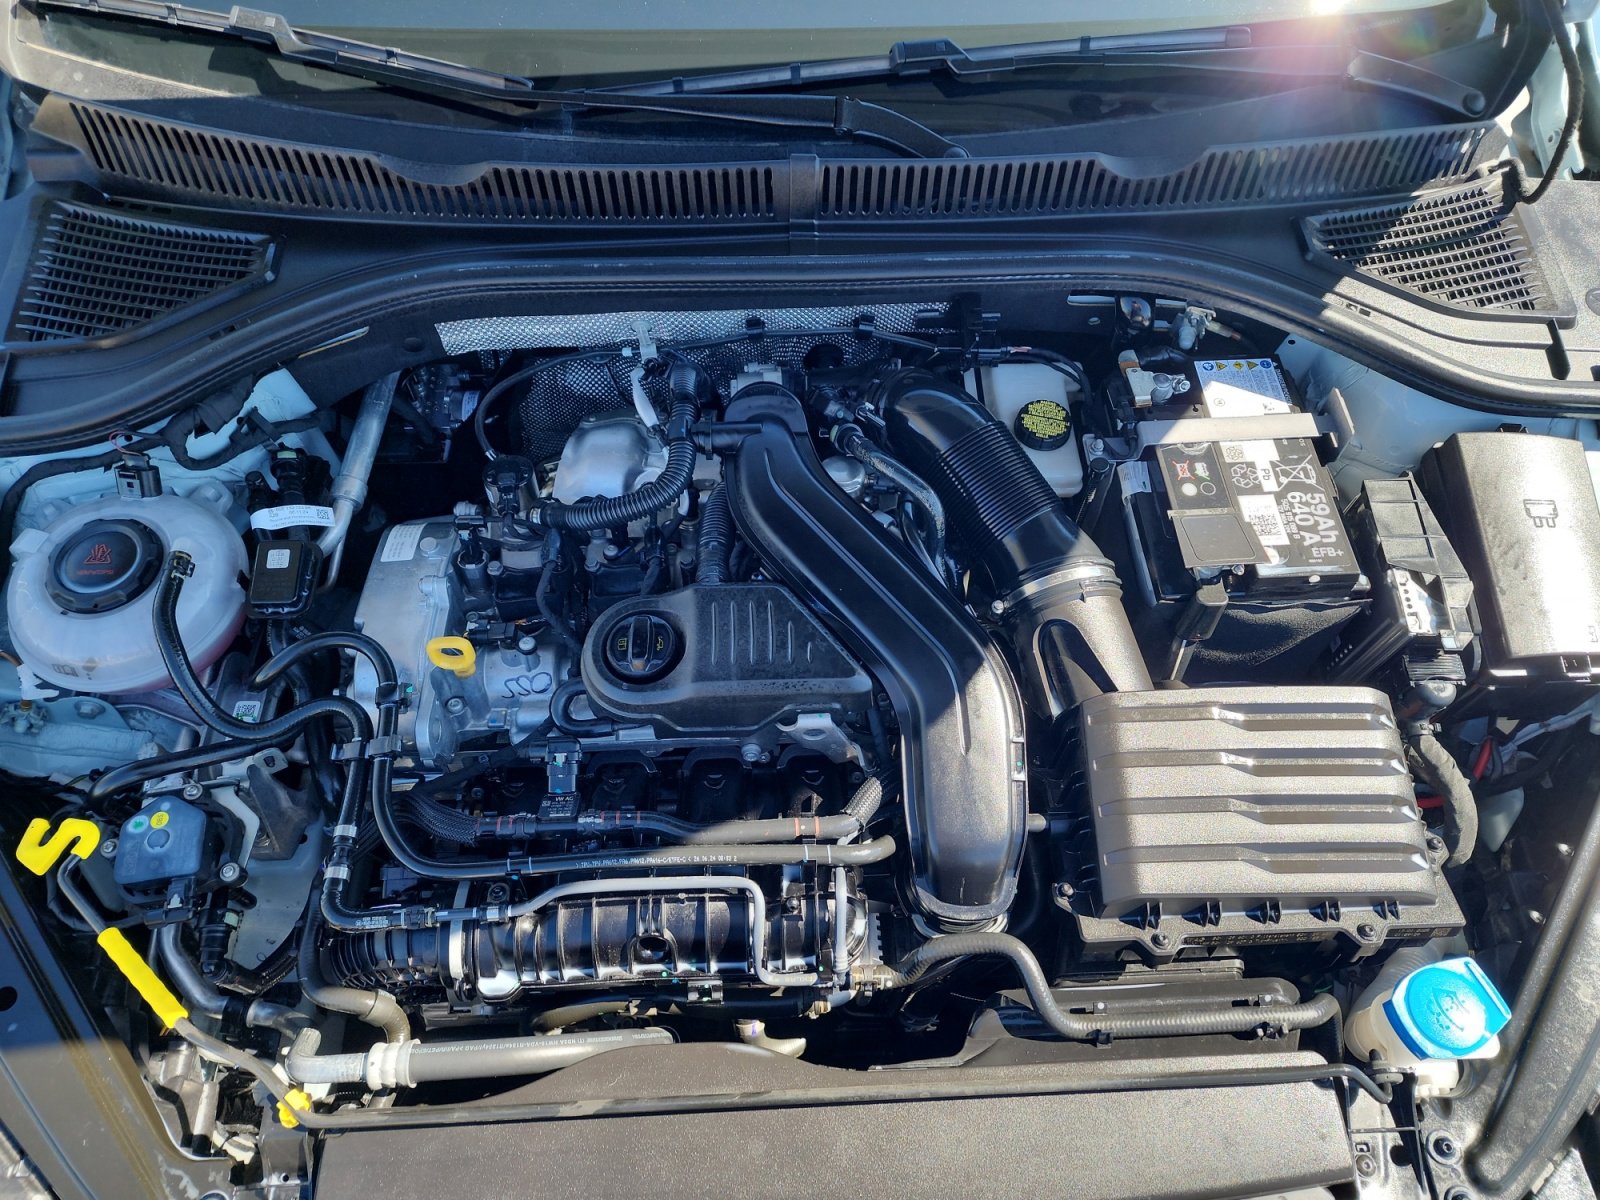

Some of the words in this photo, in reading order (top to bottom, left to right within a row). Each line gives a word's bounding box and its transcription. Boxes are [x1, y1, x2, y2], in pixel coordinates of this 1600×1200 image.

[1261, 468, 1271, 481] Pb
[1287, 491, 1315, 526] 640
[1307, 493, 1340, 543] 59Ah
[1300, 531, 1321, 546] A
[1311, 547, 1344, 558] EFB+
